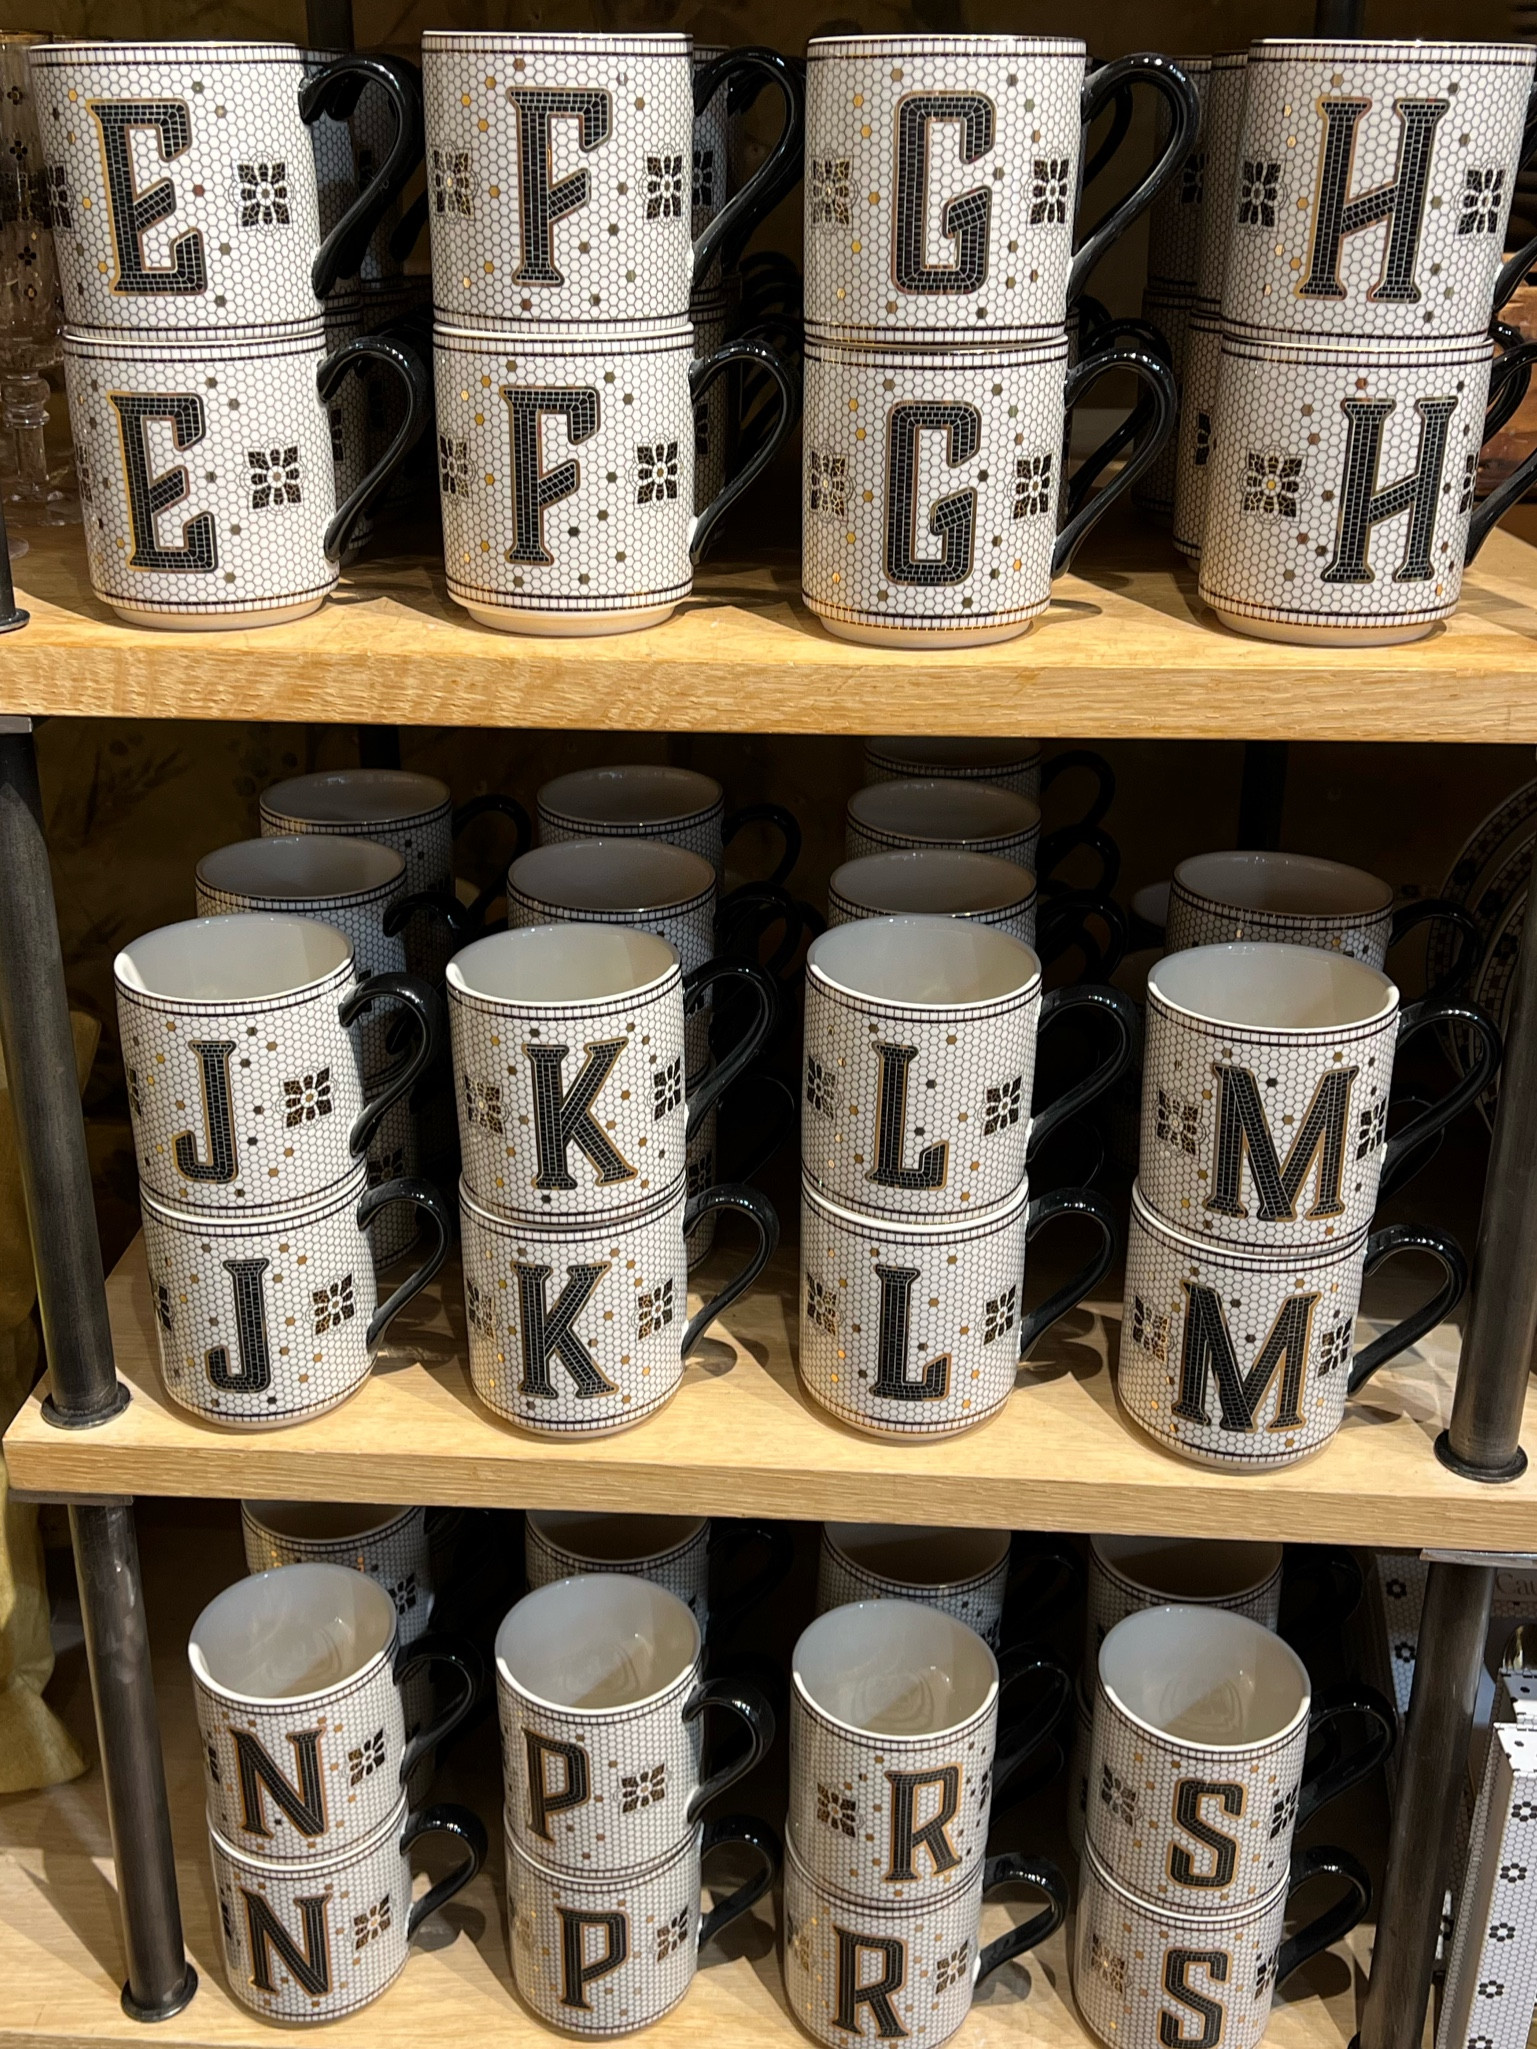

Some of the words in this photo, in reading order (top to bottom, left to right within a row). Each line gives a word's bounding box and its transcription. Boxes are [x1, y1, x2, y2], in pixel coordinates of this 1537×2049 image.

[86, 98, 206, 296] E
[505, 86, 612, 287] F
[892, 90, 996, 295] G
[1297, 97, 1450, 304] H
[107, 391, 217, 573] E
[501, 385, 600, 565] F
[883, 401, 981, 586] G
[1321, 396, 1459, 583] H
[171, 1040, 240, 1183] J
[522, 1036, 638, 1190] K
[866, 1041, 949, 1190] L
[1202, 1061, 1360, 1223] M
[205, 1258, 270, 1393] J
[510, 1260, 620, 1400] K
[869, 1264, 951, 1400] L
[1171, 1278, 1322, 1433] M
[230, 1726, 327, 1839] N
[520, 1727, 590, 1845] P
[882, 1763, 964, 1883] R
[1166, 1778, 1248, 1890] S
[239, 1887, 333, 1998] N
[557, 1906, 630, 2011] P
[831, 1923, 910, 2039] R
[1157, 1947, 1232, 2049] S
